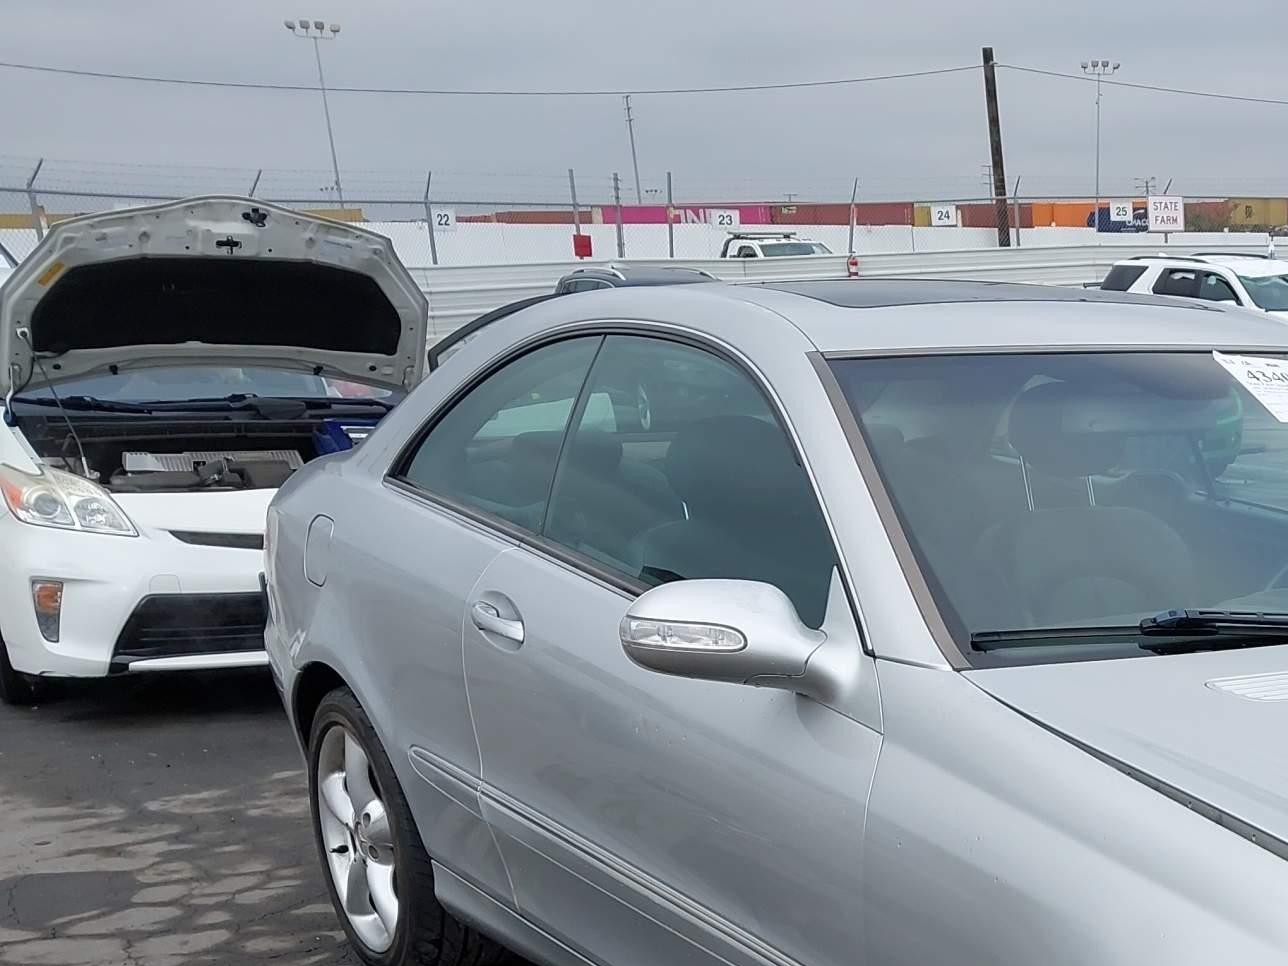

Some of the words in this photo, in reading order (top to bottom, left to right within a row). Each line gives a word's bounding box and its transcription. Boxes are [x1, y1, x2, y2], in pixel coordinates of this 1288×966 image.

[1115, 206, 1128, 216] 25
[1153, 201, 1179, 211] STATE
[437, 213, 450, 226] 22
[718, 214, 733, 226] 23
[937, 210, 950, 221] 24
[1154, 215, 1178, 225] FARM
